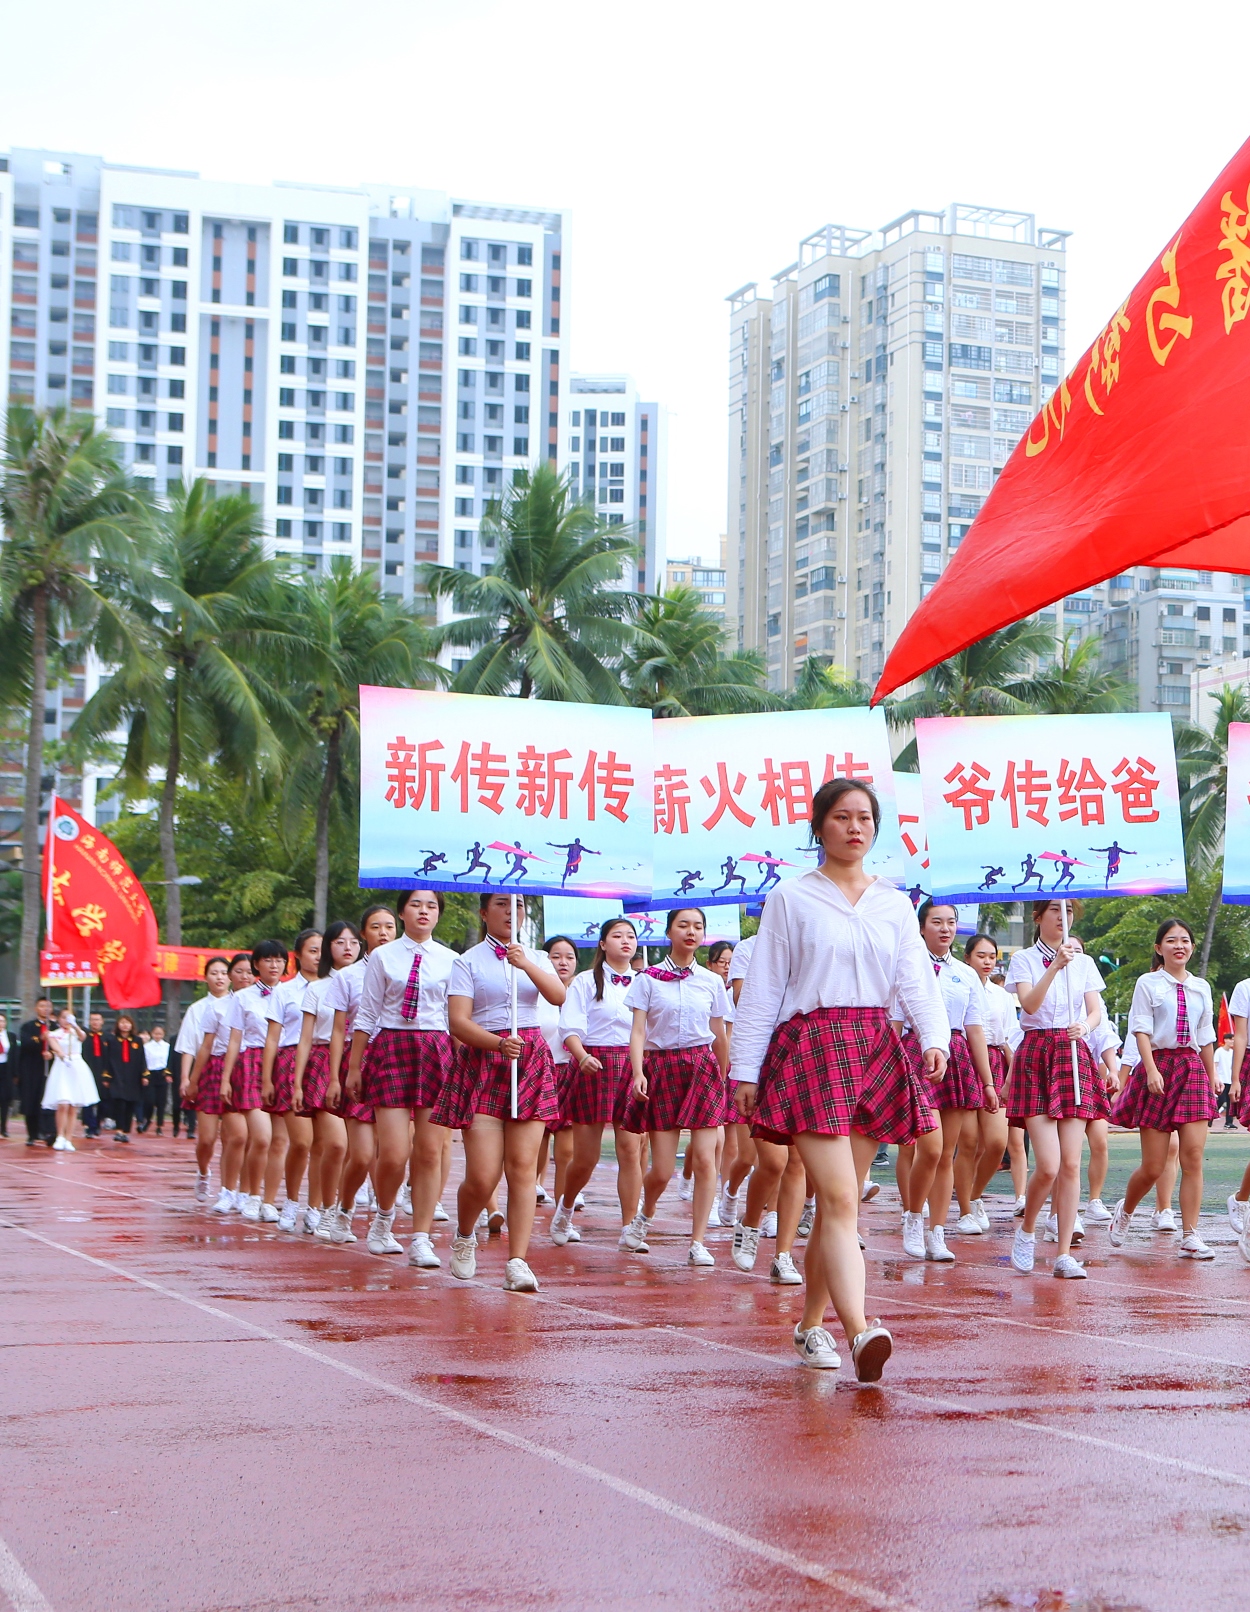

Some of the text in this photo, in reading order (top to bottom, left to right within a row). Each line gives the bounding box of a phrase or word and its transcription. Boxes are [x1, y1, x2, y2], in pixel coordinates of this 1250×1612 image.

[384, 735, 635, 824] 新传新传
[943, 756, 1161, 831] 爷传给爸
